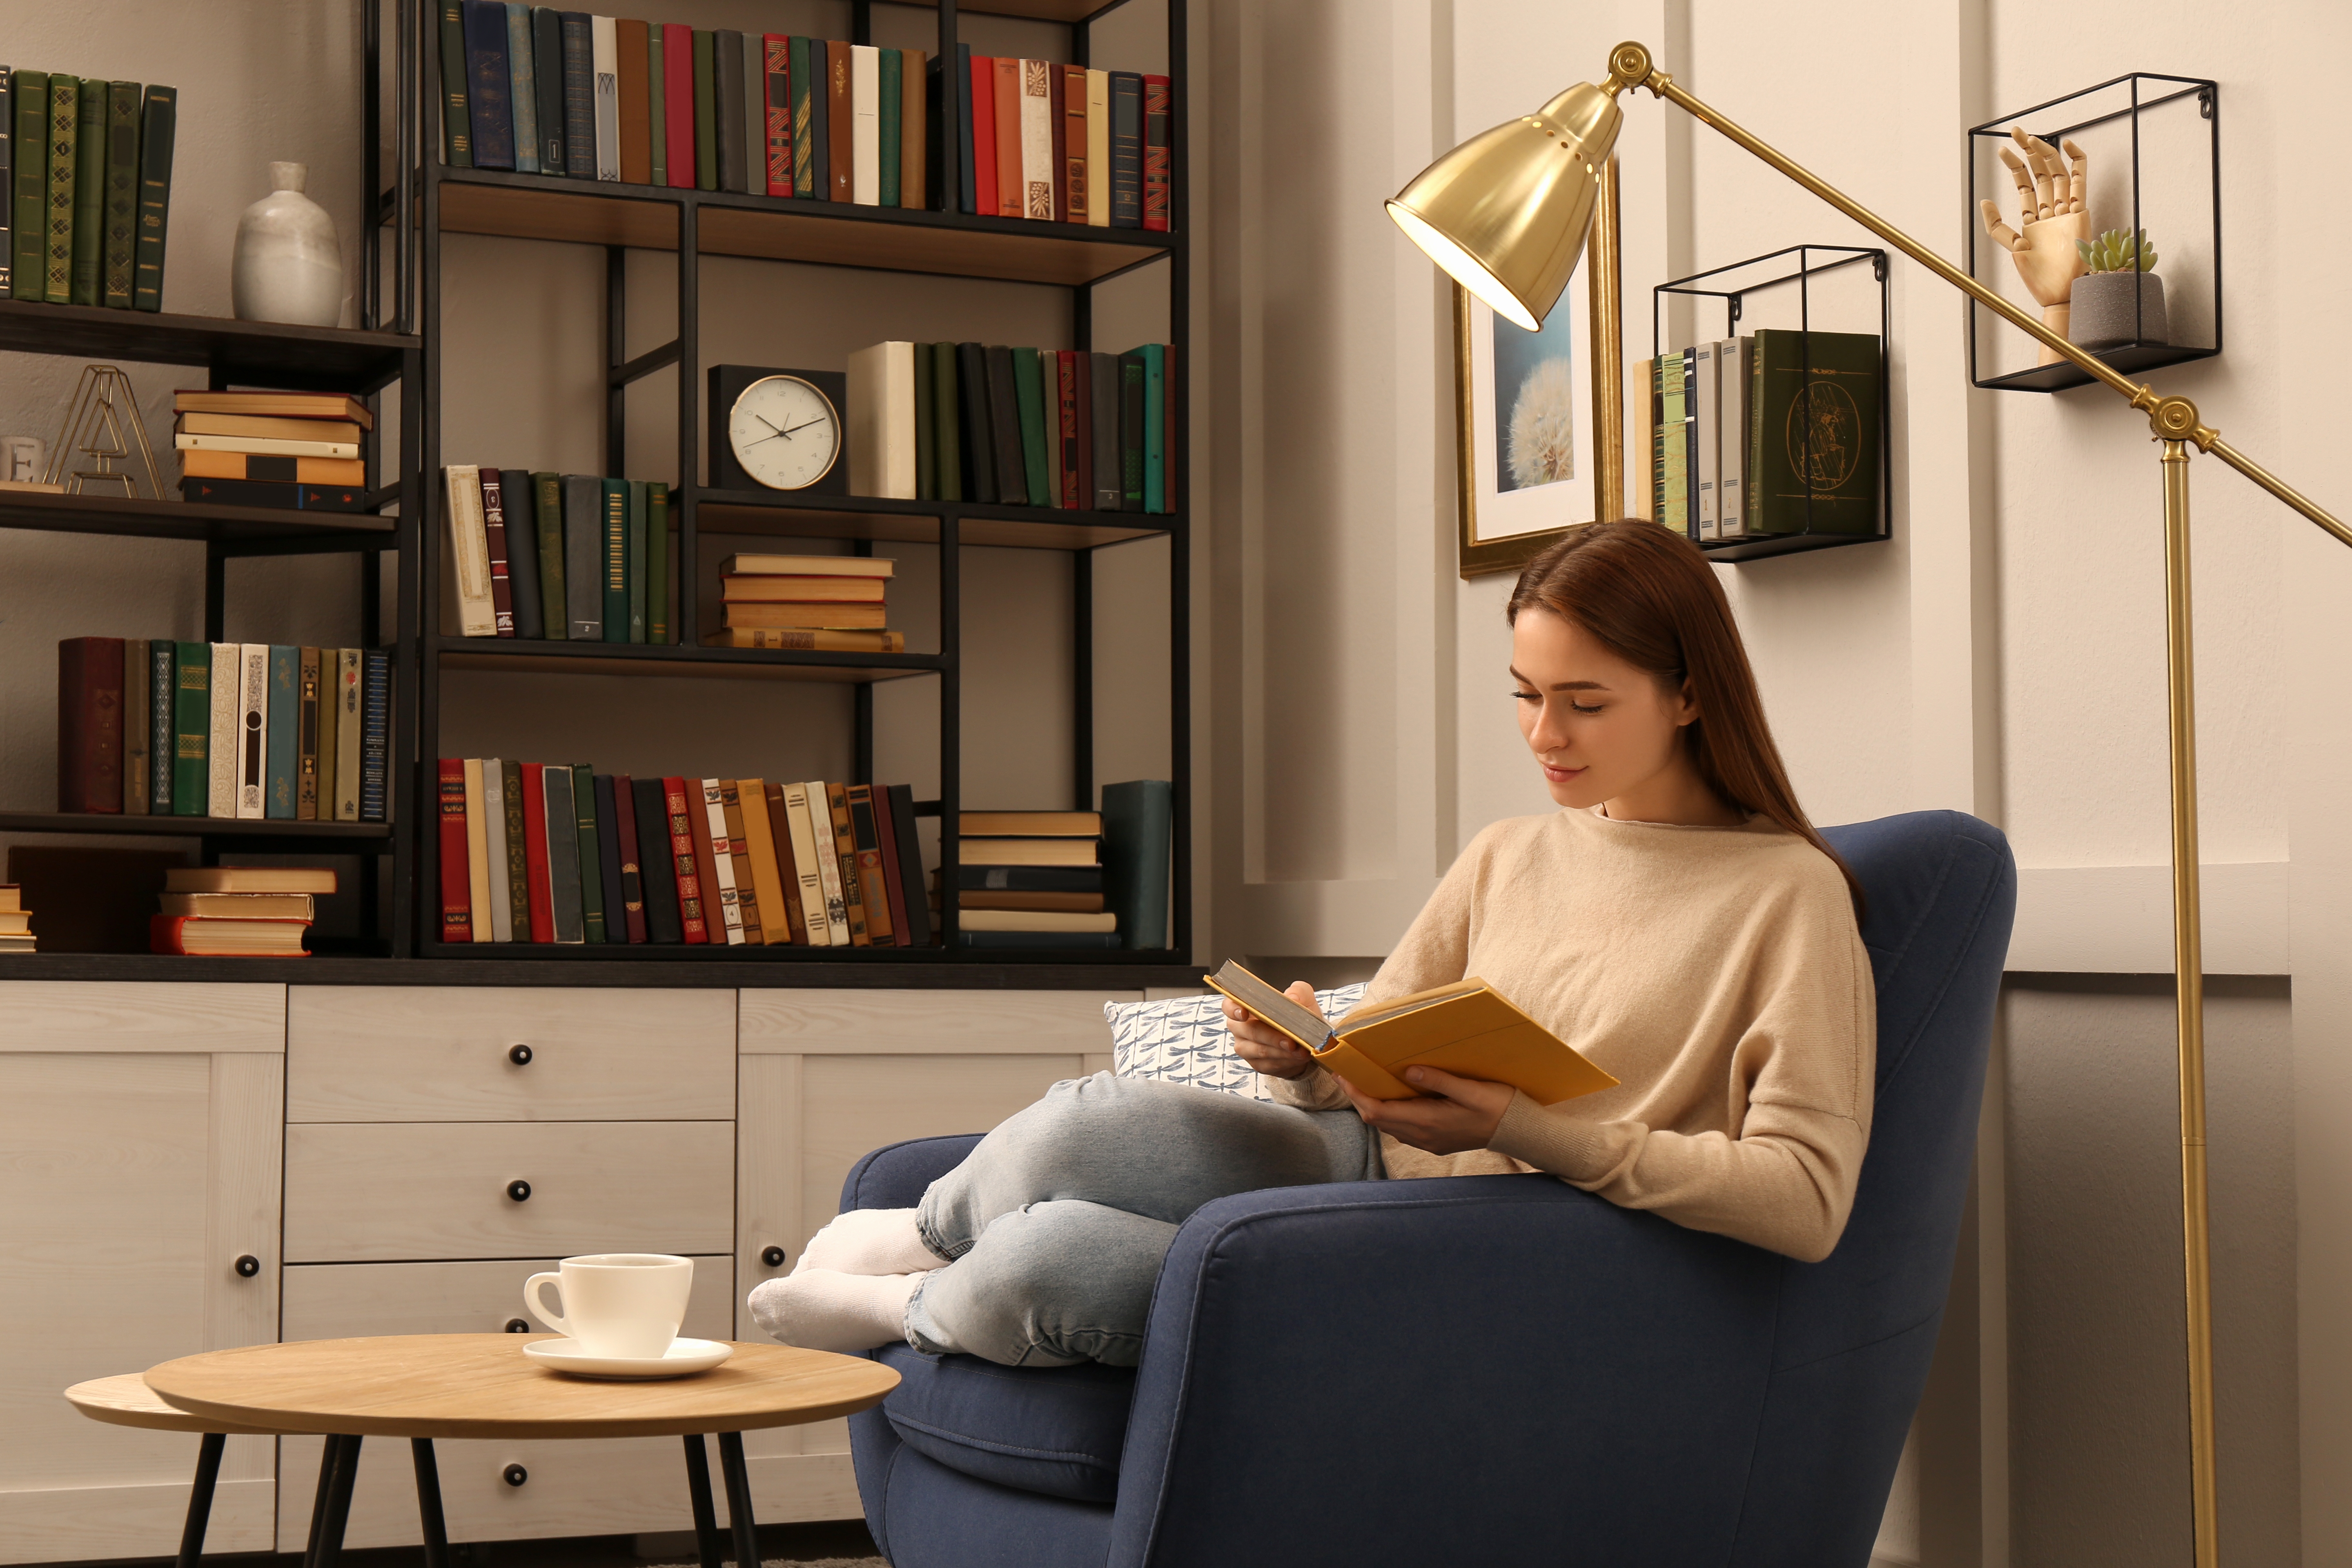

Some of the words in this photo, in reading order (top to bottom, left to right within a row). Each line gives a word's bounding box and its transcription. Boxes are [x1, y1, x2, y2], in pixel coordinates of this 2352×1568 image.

[552, 144, 556, 158] 1
[9, 443, 35, 483] E
[1704, 499, 1708, 511] 1
